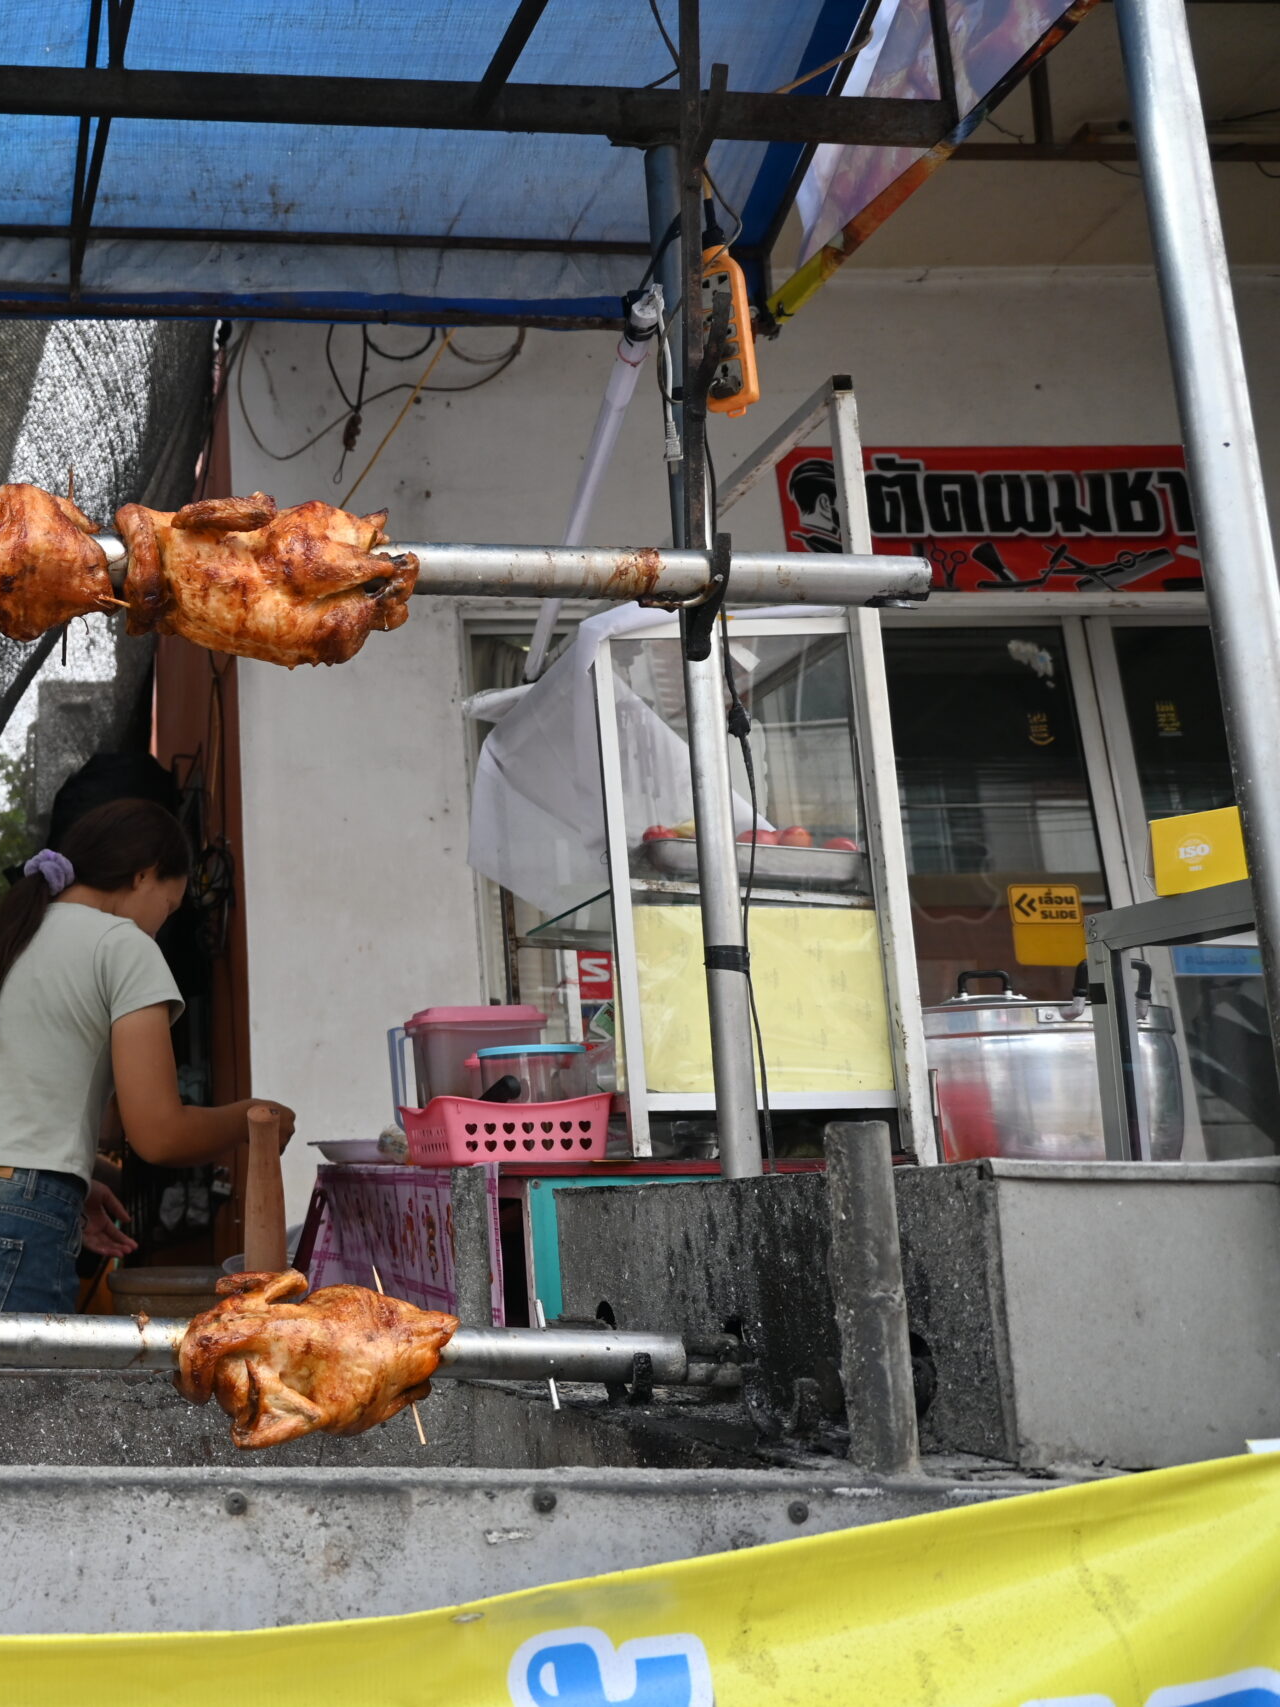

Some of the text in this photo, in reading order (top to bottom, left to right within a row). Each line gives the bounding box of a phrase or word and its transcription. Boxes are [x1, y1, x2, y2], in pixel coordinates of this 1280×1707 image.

[1178, 844, 1211, 860] ISO
[1038, 888, 1075, 905] เลื่อน
[1040, 910, 1078, 920] SLIDE
